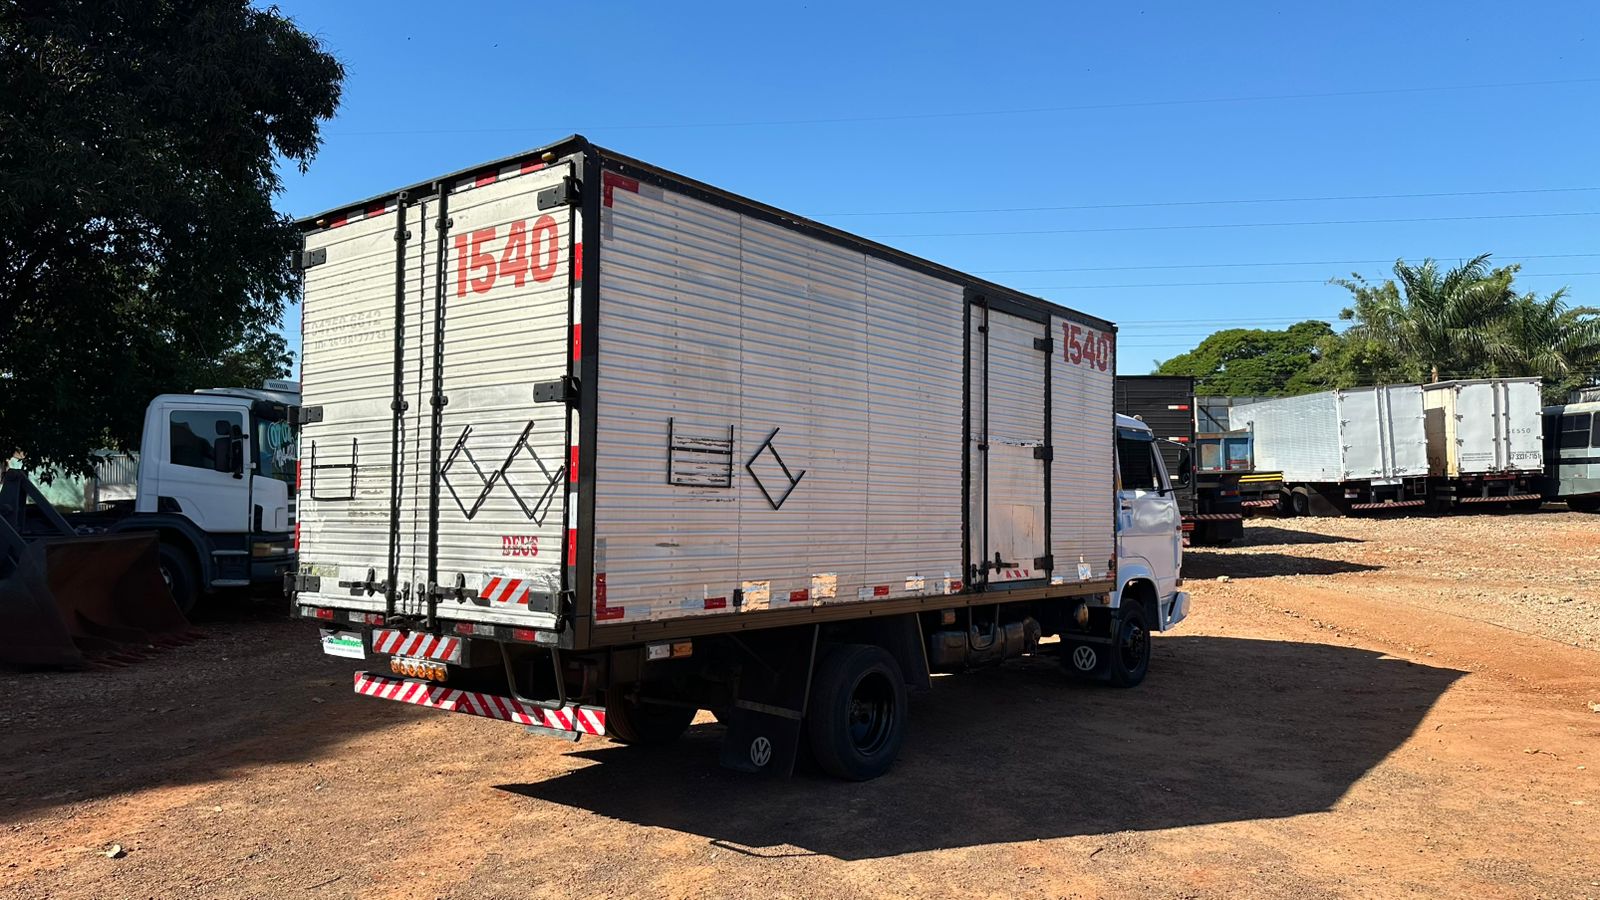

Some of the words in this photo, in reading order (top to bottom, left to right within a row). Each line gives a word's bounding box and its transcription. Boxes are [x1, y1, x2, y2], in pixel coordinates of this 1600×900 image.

[455, 214, 559, 298] 1540
[1062, 321, 1108, 372] 1540
[502, 536, 539, 556] DEUS
